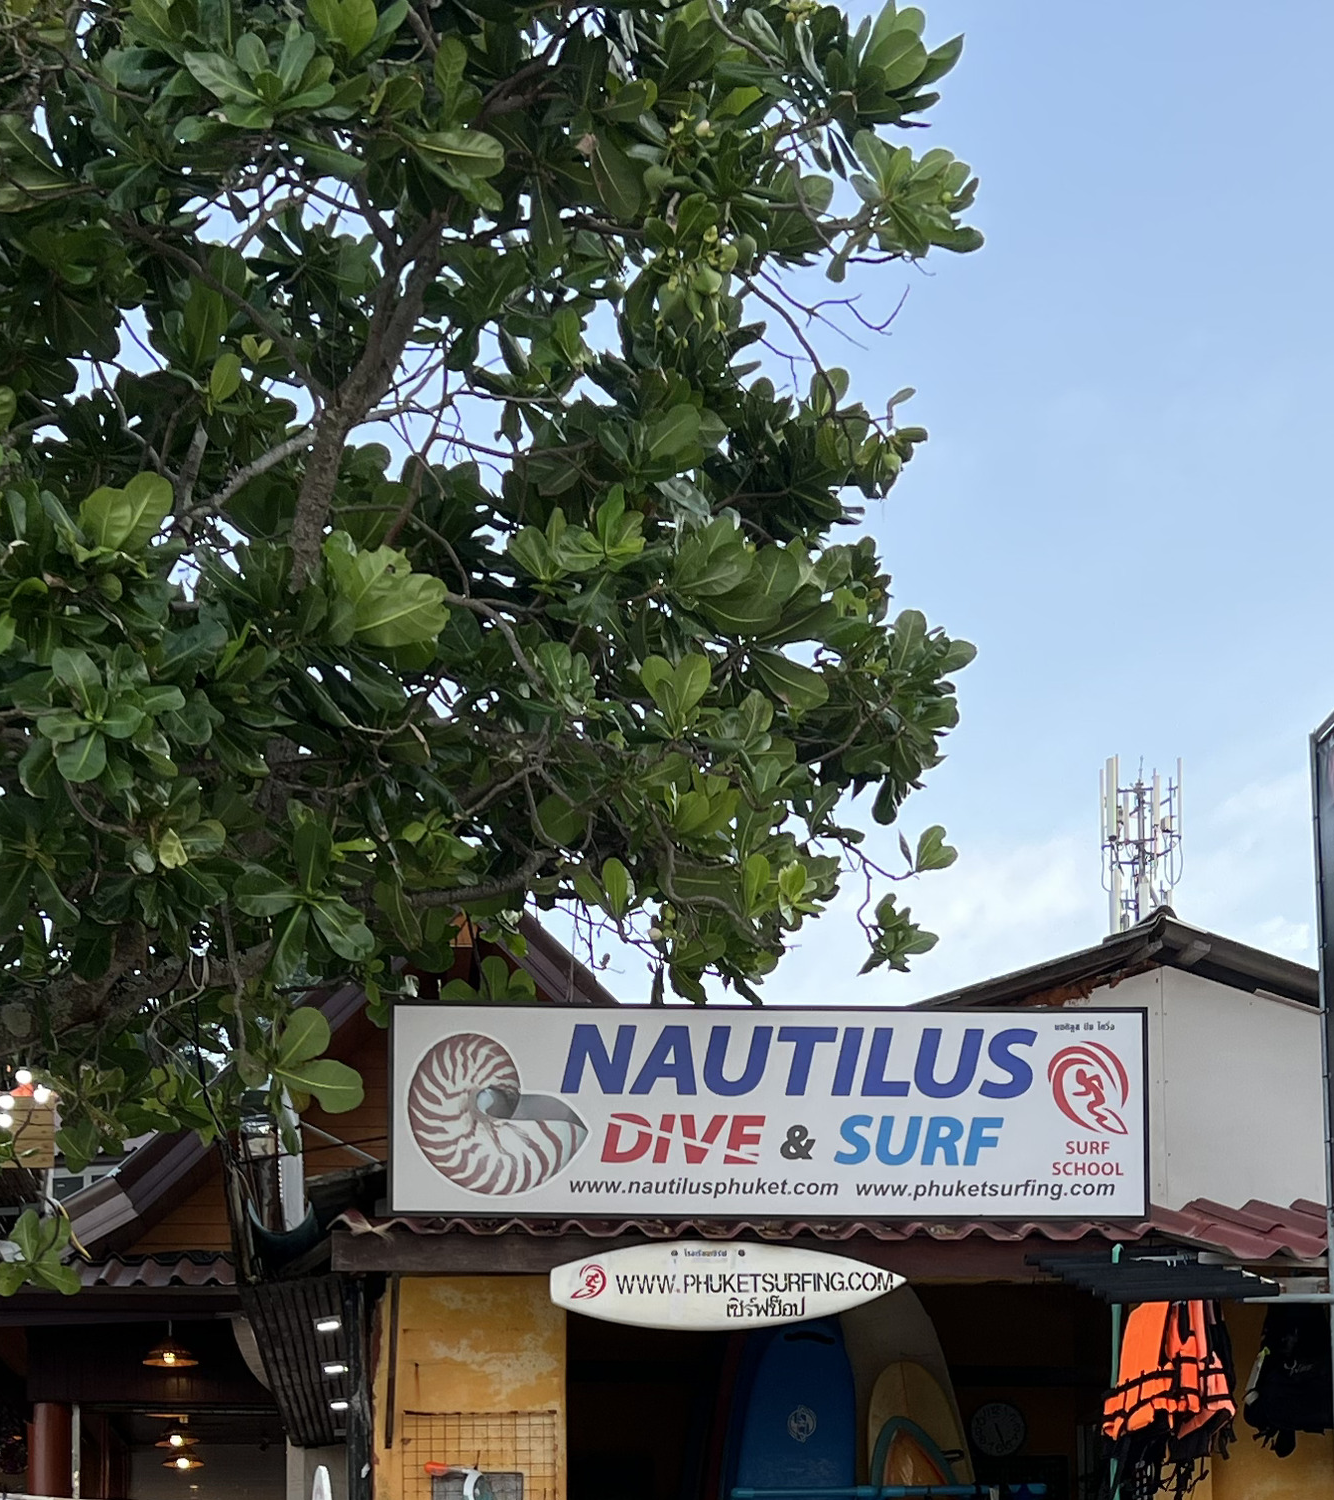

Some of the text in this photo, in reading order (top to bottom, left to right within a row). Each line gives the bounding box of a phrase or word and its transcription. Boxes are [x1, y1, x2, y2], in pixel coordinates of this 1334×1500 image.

[560, 1024, 1038, 1099] NAUTILUS
[600, 1113, 1005, 1167] DIVE & SURF
[1065, 1141, 1110, 1155] SURF
[1052, 1162, 1124, 1176] SCHOOL
[569, 1177, 1116, 1202] www.nautilusphuket.com www.phuketsurfing.com
[615, 1272, 894, 1295] WWW.PHUKETSURFING.COM
